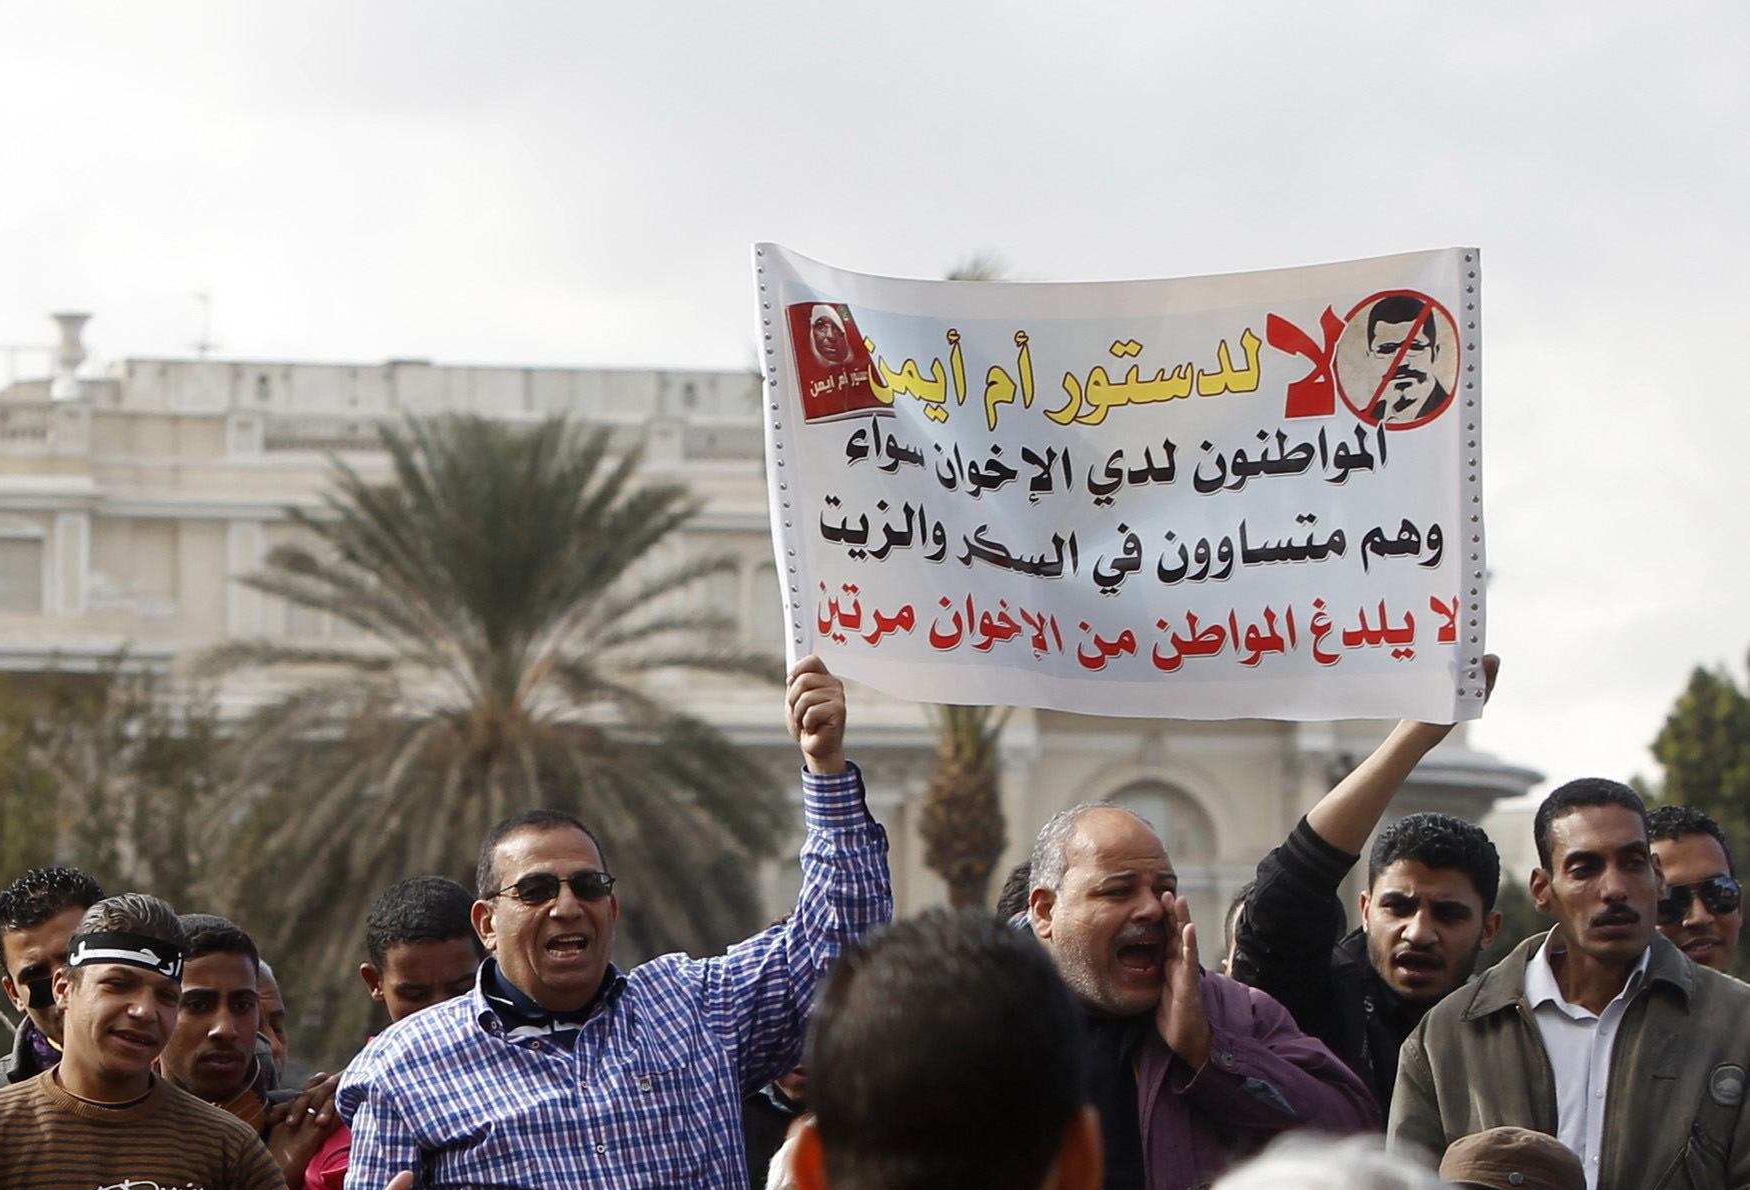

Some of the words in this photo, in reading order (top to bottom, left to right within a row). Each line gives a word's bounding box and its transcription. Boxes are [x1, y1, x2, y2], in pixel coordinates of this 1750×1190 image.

[861, 328, 967, 424] أيمن
[983, 329, 1035, 431] أم
[1043, 328, 1263, 427] لدستور
[1266, 304, 1347, 419] لا
[845, 415, 927, 474] سواء
[934, 441, 1075, 508] الإخوان
[1086, 437, 1178, 507] لدي
[1192, 422, 1388, 495] المواطنون
[819, 494, 948, 562] والزيت
[956, 523, 1081, 578] السكر
[1091, 522, 1144, 597] في
[1155, 511, 1348, 584] متساوون
[1360, 517, 1445, 575] وهم
[816, 580, 917, 647] مرتين
[928, 592, 1065, 662] الإخوان
[1077, 620, 1139, 673] من
[1151, 604, 1298, 672] المواطن
[1309, 597, 1418, 665] يلدغ
[1429, 595, 1461, 643] لا
